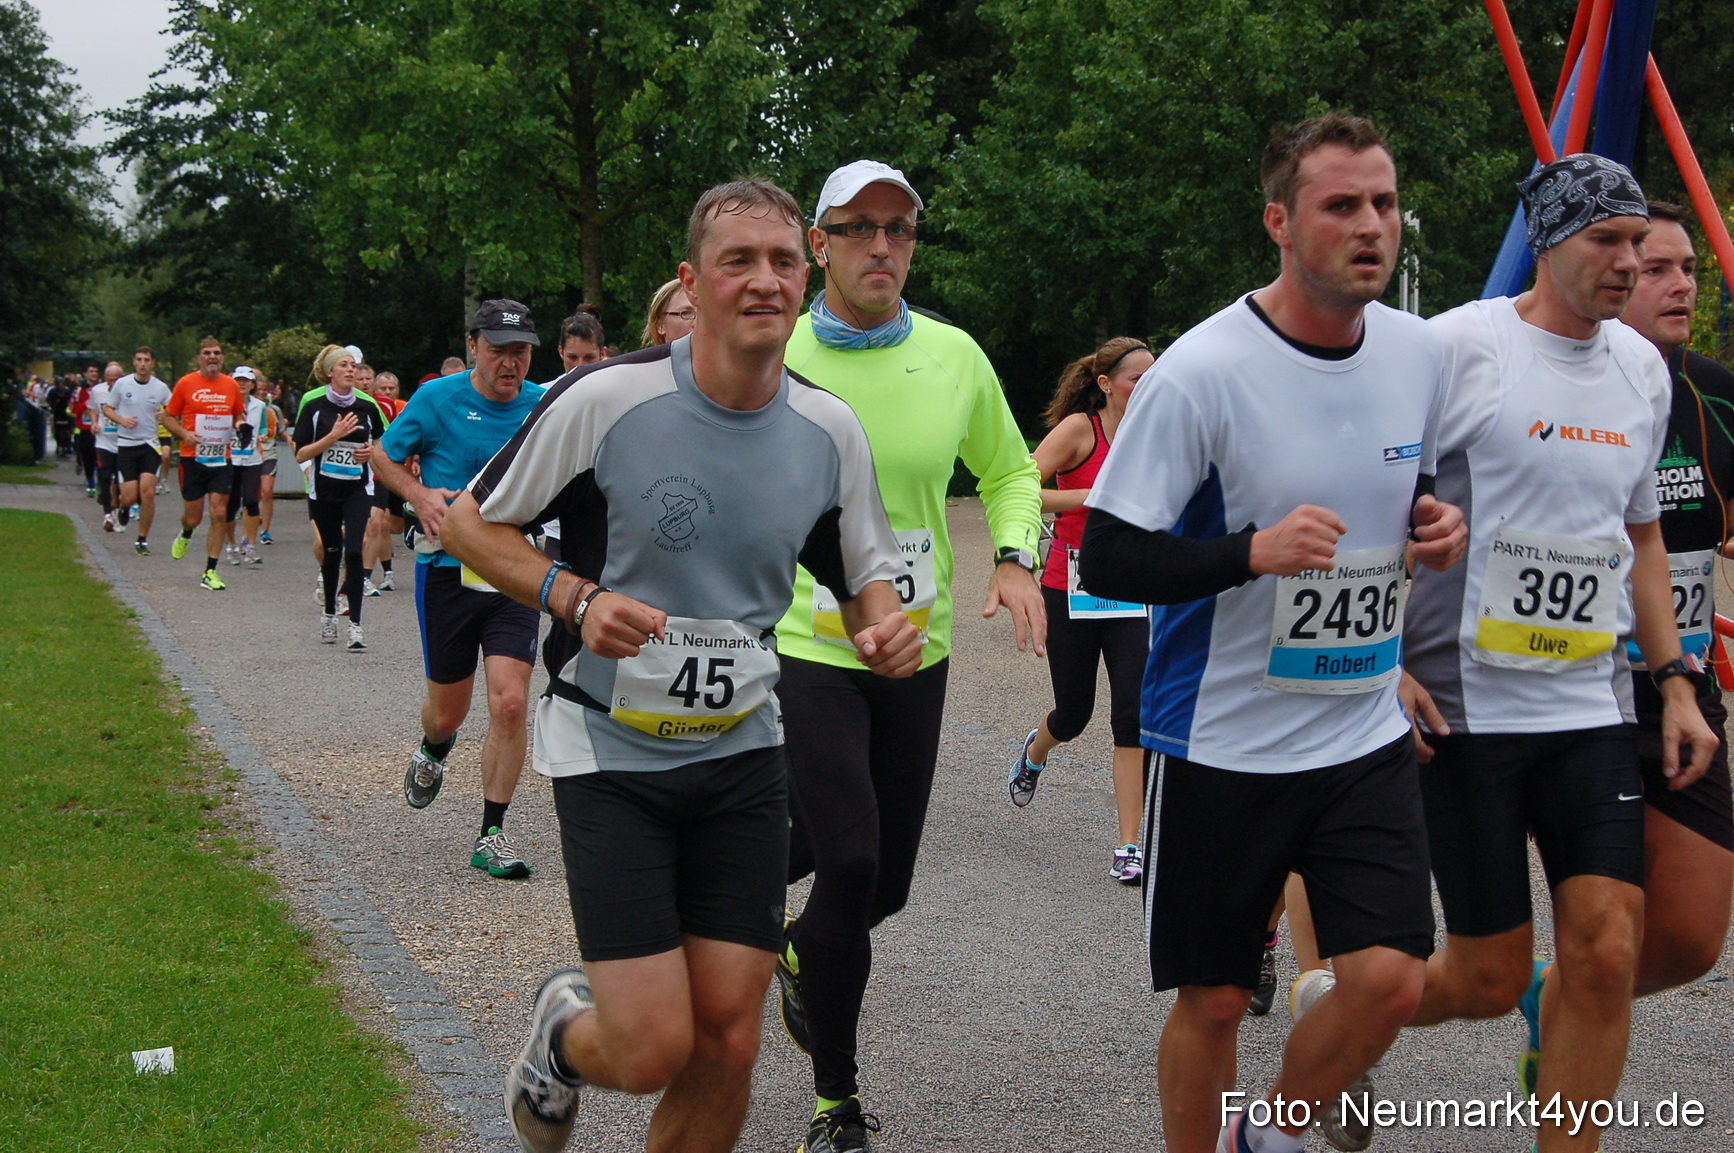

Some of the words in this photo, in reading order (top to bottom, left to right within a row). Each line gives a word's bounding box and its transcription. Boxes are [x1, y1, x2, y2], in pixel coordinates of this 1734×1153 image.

[1560, 425, 1632, 448] KLEBL
[199, 445, 224, 456] 2786
[641, 474, 688, 502] Sportverein
[690, 479, 715, 515] Lupburg
[662, 509, 690, 529] LUPBURG
[654, 537, 692, 554] Lauftreff
[898, 542, 917, 553] rkt
[1493, 540, 1543, 561] PARTL
[1547, 549, 1606, 568] Neumarkt
[1282, 567, 1334, 580] ARTL
[1337, 561, 1397, 579] Neumarkt
[1094, 599, 1119, 609] Julia
[1513, 567, 1599, 624] 392
[1289, 579, 1399, 640] 2436
[682, 633, 755, 649] Neumarkt
[1528, 632, 1568, 655] Uwe
[1314, 651, 1376, 675] Robert
[668, 656, 735, 709] 45
